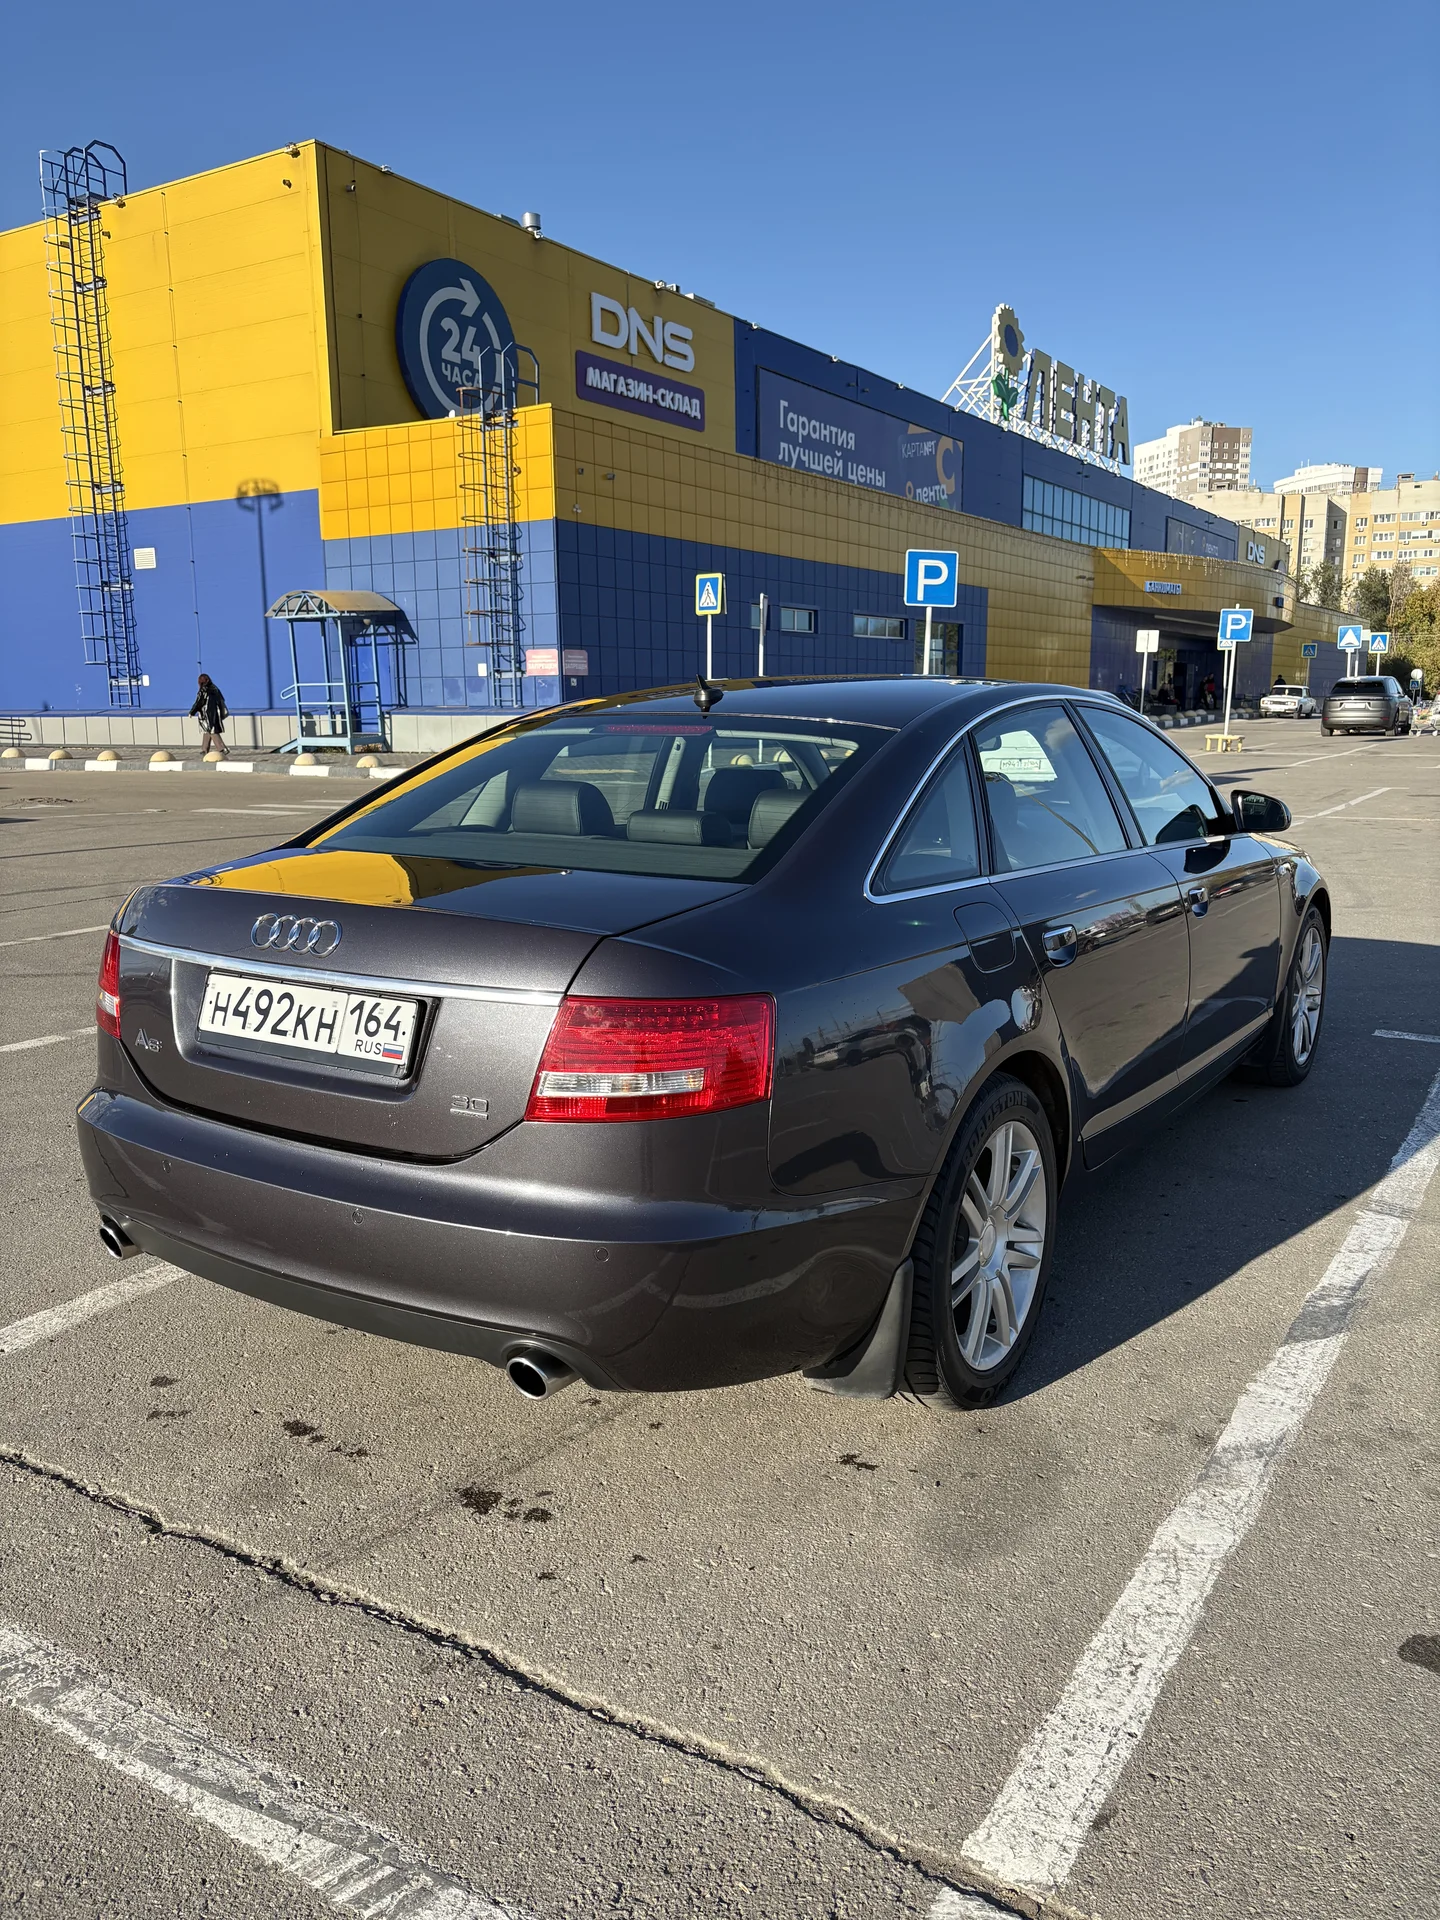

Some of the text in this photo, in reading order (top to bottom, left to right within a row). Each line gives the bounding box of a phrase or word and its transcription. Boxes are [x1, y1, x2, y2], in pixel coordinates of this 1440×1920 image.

[440, 317, 480, 370] 24
[591, 292, 695, 373] DNS
[586, 366, 701, 420] МАГАЗИН-СКЛАД
[1023, 348, 1130, 466] ЛЕНТА
[780, 399, 855, 451] Гарантия
[778, 441, 886, 488] лучшей цены
[1247, 541, 1265, 565] DNS
[350, 1000, 402, 1042] 164
[354, 1039, 382, 1056] RUS
[963, 1090, 1029, 1167] ROADSTONE
